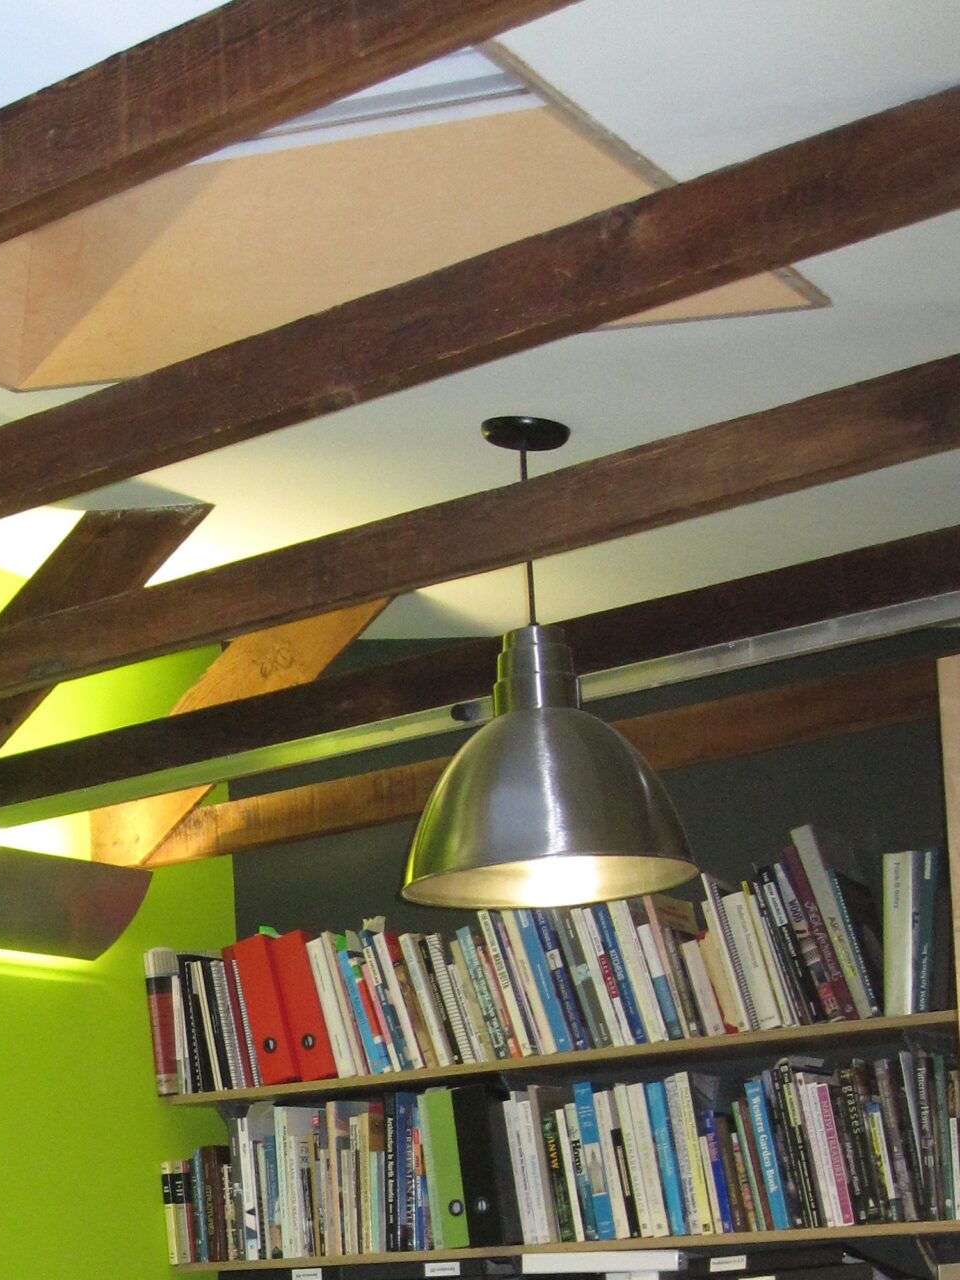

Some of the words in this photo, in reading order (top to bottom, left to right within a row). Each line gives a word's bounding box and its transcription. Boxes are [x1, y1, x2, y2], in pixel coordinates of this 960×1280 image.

[787, 898, 804, 924] WOOD
[750, 1095, 766, 1133] Western
[840, 1084, 860, 1135] grasses
[386, 1117, 394, 1152] Architecture
[758, 1133, 773, 1167] Garden
[820, 1099, 834, 1132] NATIVE
[827, 1134, 844, 1183] TREASURES
[570, 1139, 585, 1175] Home
[765, 1168, 779, 1193] Book
[405, 1196, 413, 1228] STYLE
